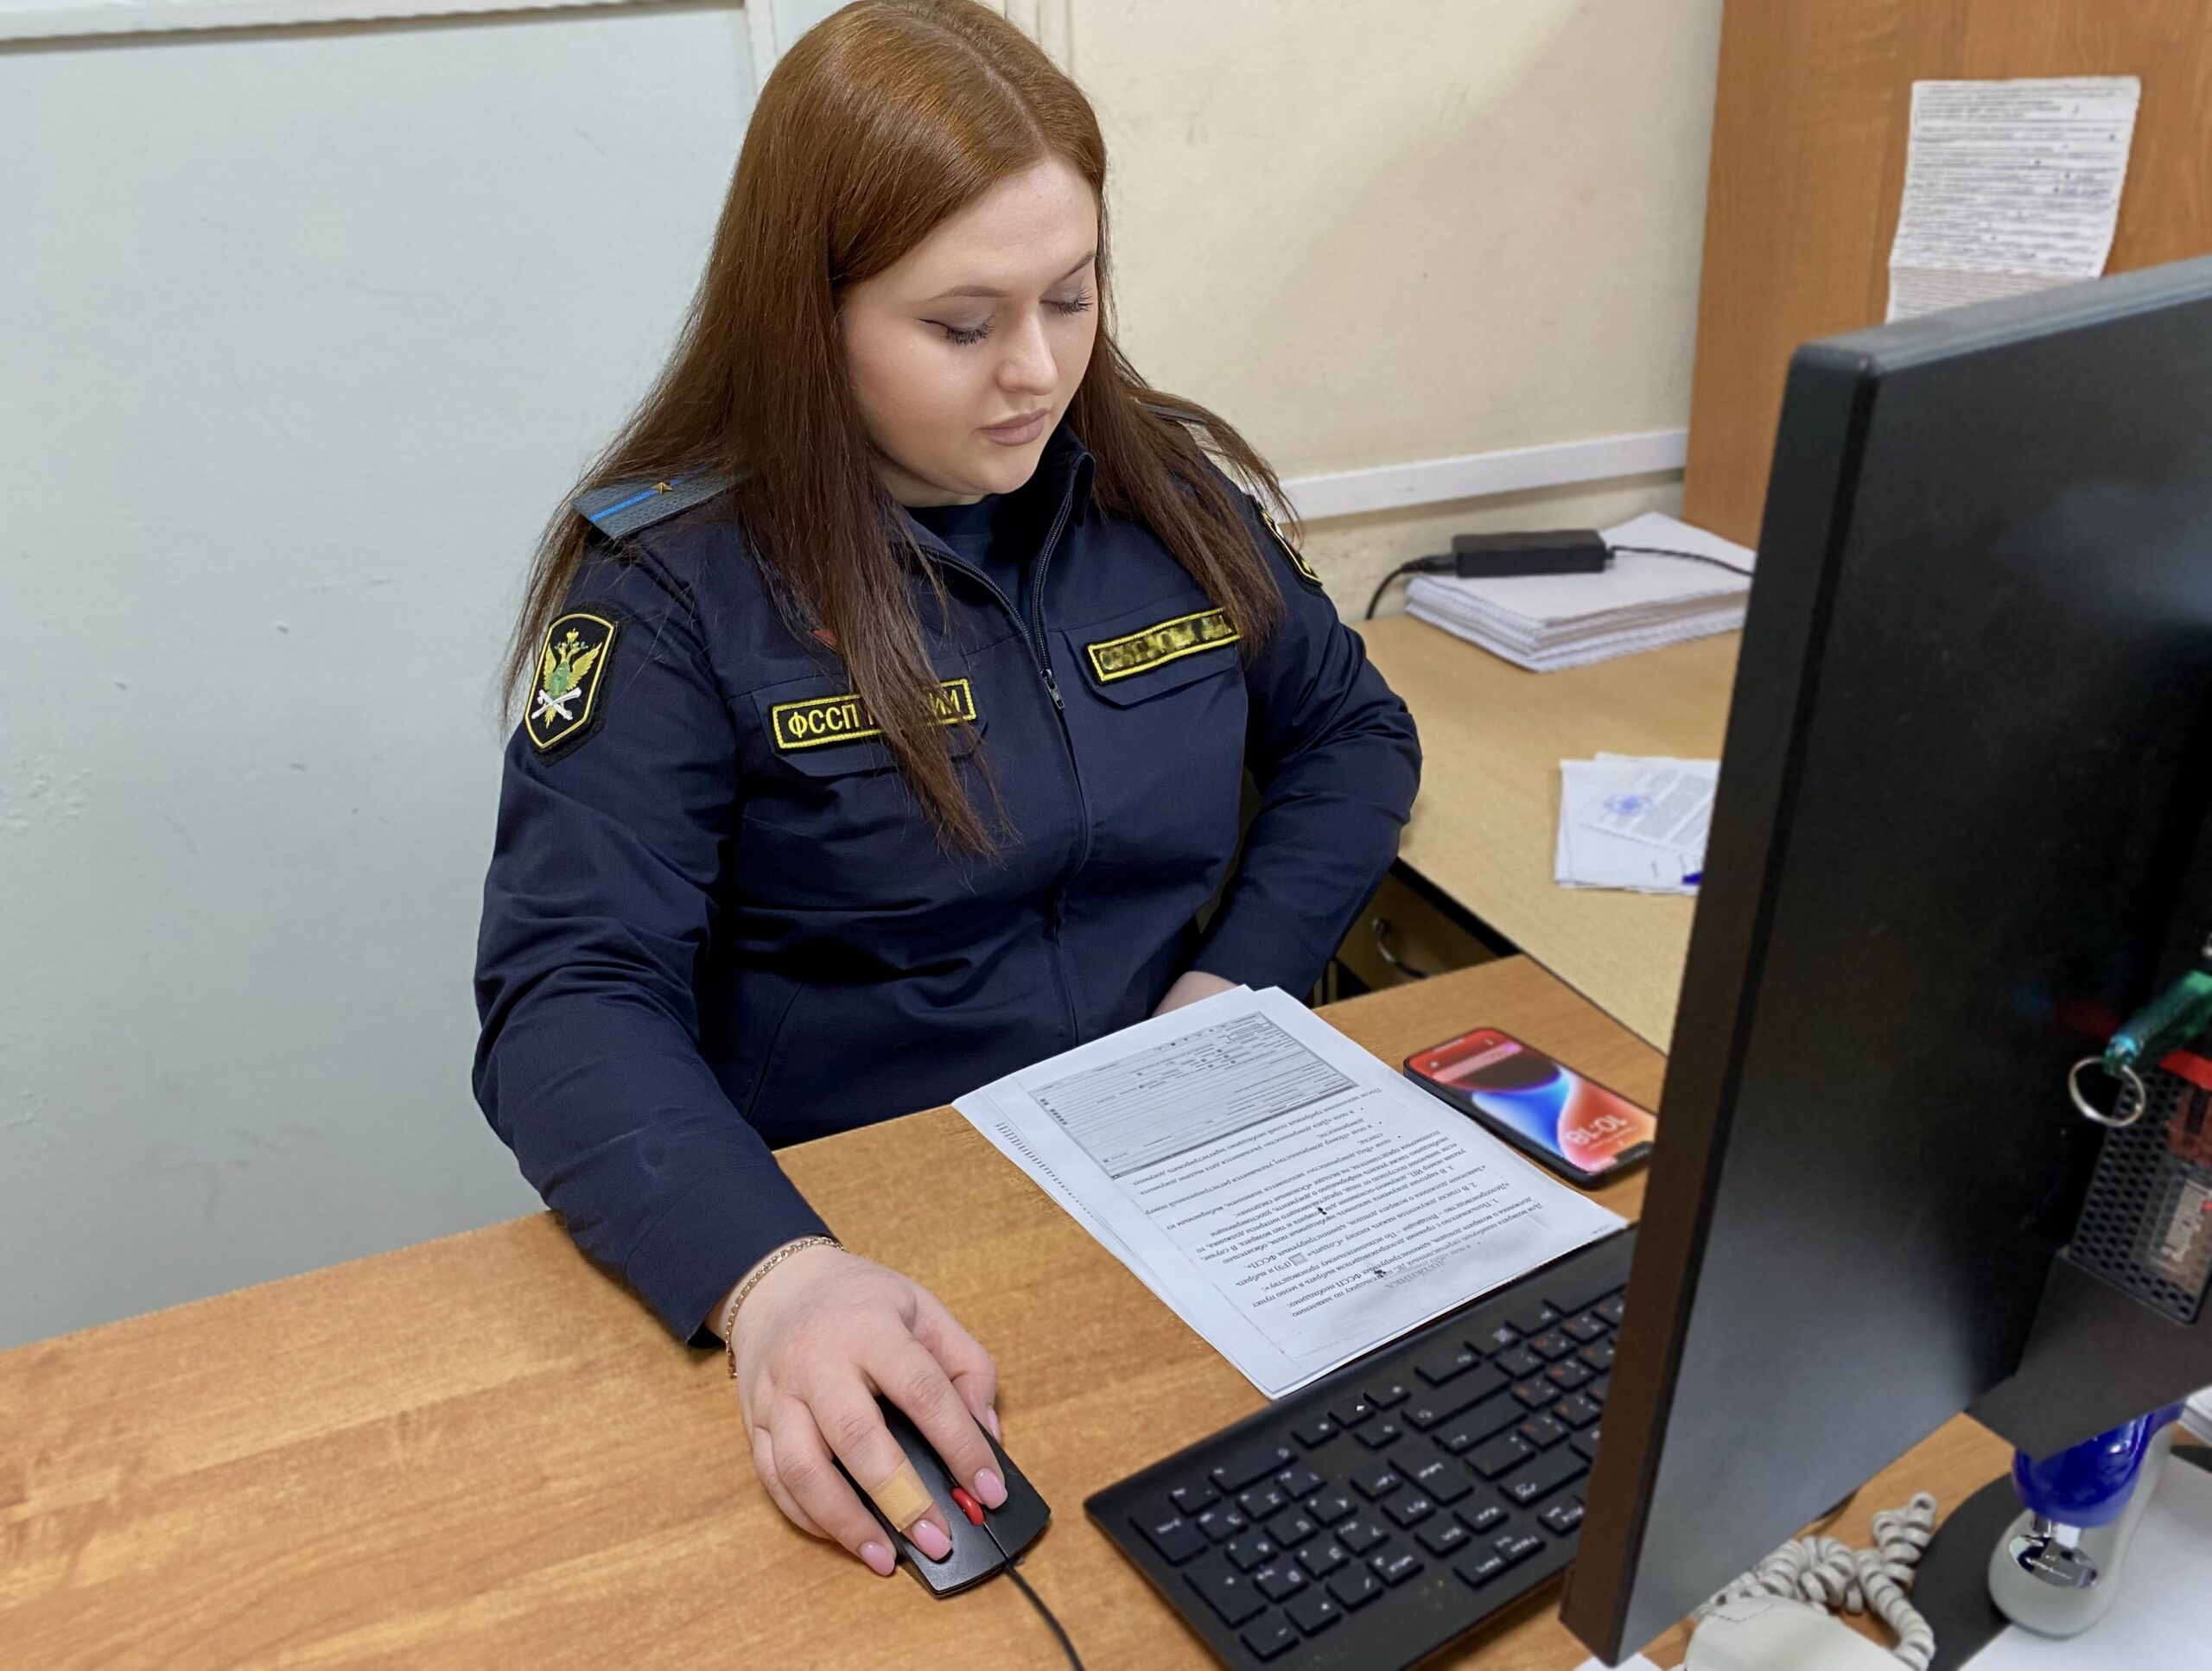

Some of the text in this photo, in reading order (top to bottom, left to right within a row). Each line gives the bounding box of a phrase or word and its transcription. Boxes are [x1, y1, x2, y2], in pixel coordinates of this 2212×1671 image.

[788, 703, 860, 738] ФССП
[1358, 1087, 1382, 1098] После
[1266, 1122, 1288, 1135] полей
[1311, 1118, 1332, 1128] «Дата
[1565, 1115, 1627, 1147] 10:18
[1225, 1130, 1268, 1150] необходимо
[1262, 1124, 1313, 1147] доверенности»
[1323, 1132, 1351, 1146] «Номер
[1356, 1132, 1383, 1146] списка;
[1219, 1143, 1263, 1165] указывается
[1354, 1145, 1375, 1155] «Вид
[1408, 1135, 1449, 1157] необходимо
[1439, 1141, 1458, 1153] если
[1166, 1147, 1227, 1173] зарегистрировать
[1203, 1160, 1221, 1172] дата
[1305, 1151, 1357, 1174] доверенности»
[1361, 1160, 1389, 1175] указать
[1387, 1153, 1410, 1166] также
[1421, 1158, 1445, 1171] номер
[1129, 1169, 1166, 1186] документ.
[1230, 1160, 1274, 1183] указывается
[1312, 1171, 1341, 1185] вкладке
[1370, 1164, 1408, 1183] поступило
[1406, 1167, 1424, 1178] ИП,
[1408, 1171, 1440, 1186] карточке
[1446, 1164, 1486, 1184] «Заявление
[1262, 1172, 1306, 1192] заполняется
[1316, 1172, 1363, 1193] информацию
[1336, 1173, 1408, 1205] документ-основание
[1341, 1182, 1363, 1192] лица,
[1413, 1179, 1448, 1198] должника
[1167, 1179, 1232, 1208] регистрационный
[1222, 1189, 1264, 1207] значением,
[1272, 1182, 1313, 1202] «Основные
[1370, 1182, 1409, 1202] документа
[1436, 1187, 1462, 1201] списке
[1442, 1181, 1510, 1214] «Делопроизводство
[1141, 1204, 1168, 1216] номер
[1270, 1191, 1312, 1212] документе,
[1280, 1190, 1344, 1220] представляющего
[1323, 1201, 1338, 1211] для
[1335, 1198, 1373, 1216] заполнить
[1377, 1197, 1409, 1214] возврате
[1395, 1197, 1438, 1218] документов
[1497, 1195, 1535, 1215] должника
[1525, 1201, 1543, 1212] Для
[1175, 1204, 1224, 1227] выбираемым
[1292, 1205, 1327, 1224] озврата
[1345, 1209, 1378, 1225] доходов,
[1440, 1200, 1492, 1225] Пользователю
[1496, 1209, 1529, 1225] возврата
[1209, 1208, 1273, 1237] удостоверяющем
[1244, 1216, 1281, 1234] интересы
[1271, 1224, 1287, 1234] тип
[1287, 1213, 1337, 1237] необходимые
[1370, 1215, 1397, 1229] нажать
[1401, 1212, 1440, 1232] Входящие
[1461, 1214, 1494, 1230] возврате
[1205, 1229, 1245, 1248] должника,
[1236, 1230, 1273, 1247] возврата.
[1264, 1233, 1289, 1247] поля,
[1275, 1223, 1347, 1257] администрируемых
[1344, 1225, 1372, 1242] кнопку
[1382, 1230, 1398, 1239] По
[1404, 1224, 1436, 1241] правами
[1429, 1226, 1463, 1243] доходов,
[1459, 1222, 1499, 1242] ошибочно
[1199, 1247, 1230, 1261] случае,
[1221, 1242, 1268, 1264] обязательно
[1306, 1238, 1344, 1256] «Создать»
[1319, 1236, 1384, 1268] исполнительному
[1334, 1236, 1405, 1271] делопроизводителя
[1405, 1237, 1462, 1268] перечисленных
[1273, 1260, 1292, 1272] (F9)
[1360, 1241, 1432, 1275] администрируемых
[1303, 1268, 1337, 1284] выбрать
[1382, 1256, 1446, 1292] ДОЛЖНИКА
[1392, 1261, 1410, 1274] ДС
[1234, 1269, 1268, 1287] выбрать
[1333, 1273, 1362, 1287] ФССП
[1274, 1284, 1299, 1298] меню
[1286, 1283, 1336, 1308] необходимо:
[1332, 1290, 1345, 1299] по
[1251, 1293, 1276, 1308] пункт
[1291, 1294, 1334, 1318] заявлению
